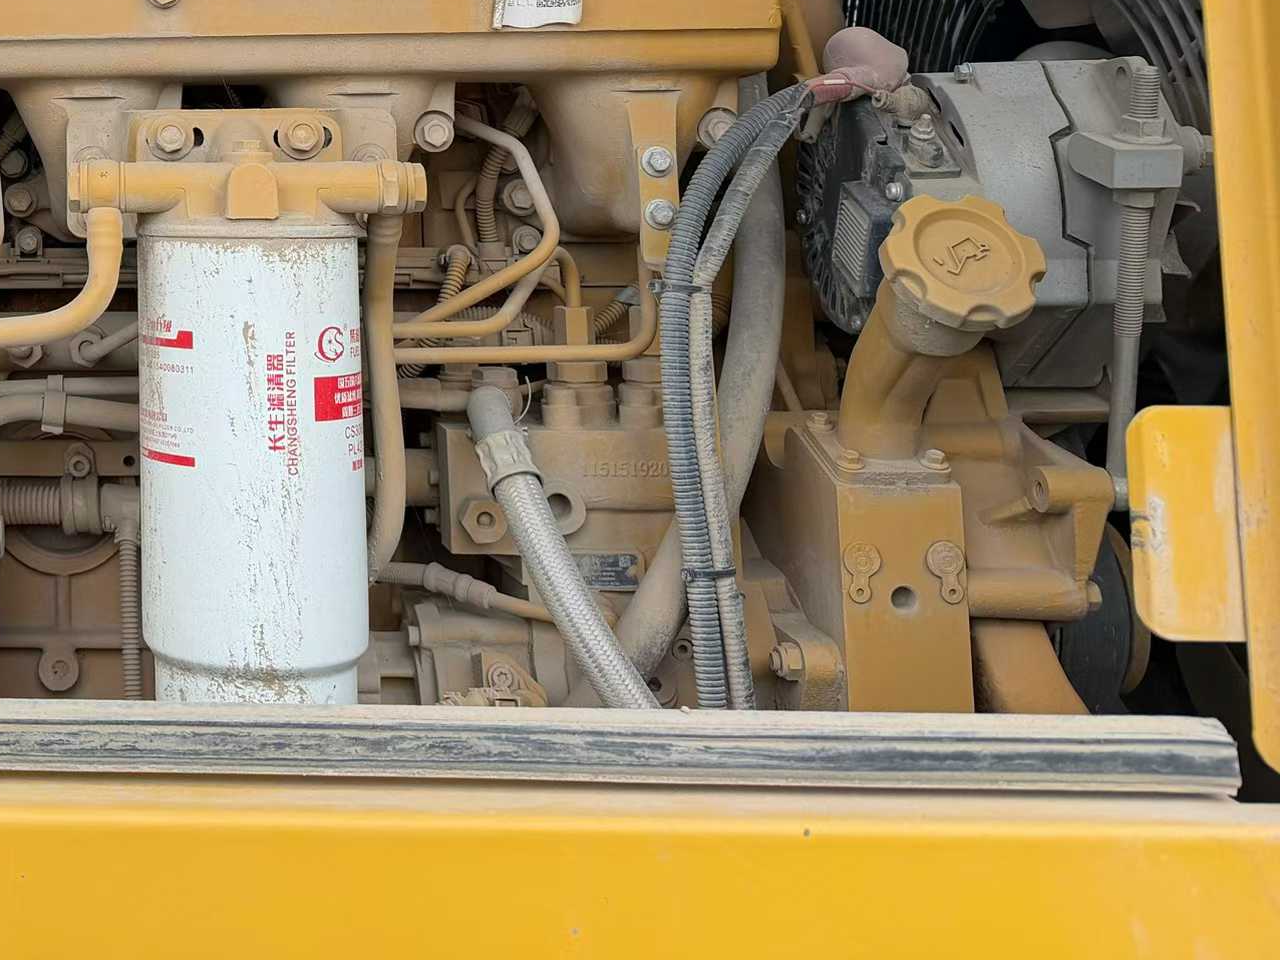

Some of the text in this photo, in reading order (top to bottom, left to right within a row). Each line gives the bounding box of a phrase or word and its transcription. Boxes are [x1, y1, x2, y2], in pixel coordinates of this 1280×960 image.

[266, 353, 286, 453] 长生滤清器
[285, 330, 299, 476] CHANGSHENG FILTER
